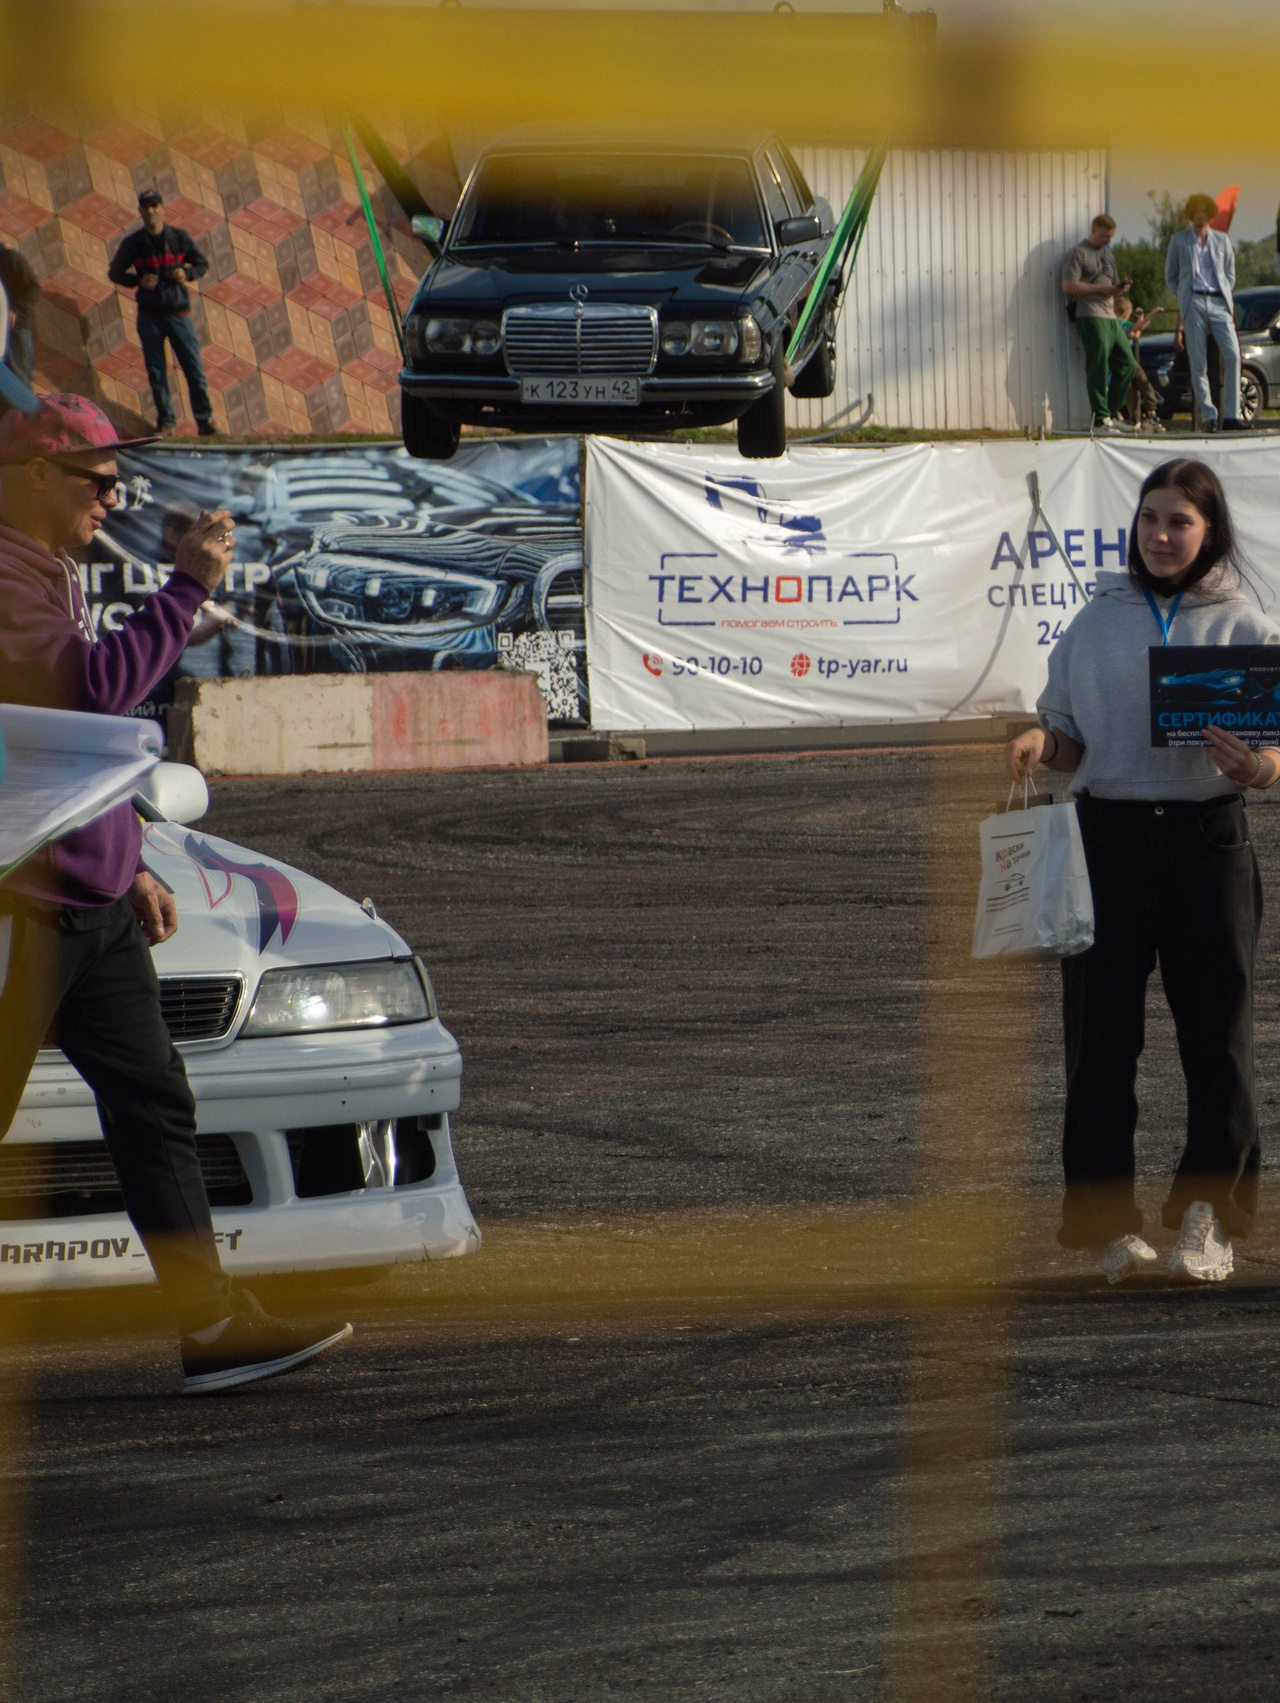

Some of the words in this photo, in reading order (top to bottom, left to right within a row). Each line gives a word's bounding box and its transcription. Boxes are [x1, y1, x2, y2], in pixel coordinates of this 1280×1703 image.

[990, 528, 1127, 570] АРЕН
[123, 562, 271, 594] ЦЕТР
[648, 574, 920, 603] ТЕХНОПАРК
[988, 582, 1097, 609] СПЕЦТЕ
[786, 619, 838, 631] строить
[672, 656, 763, 676] 90-10-10
[817, 655, 908, 678] tp-yar.ru
[1168, 738, 1185, 747] (при
[1251, 738, 1279, 747] студии)
